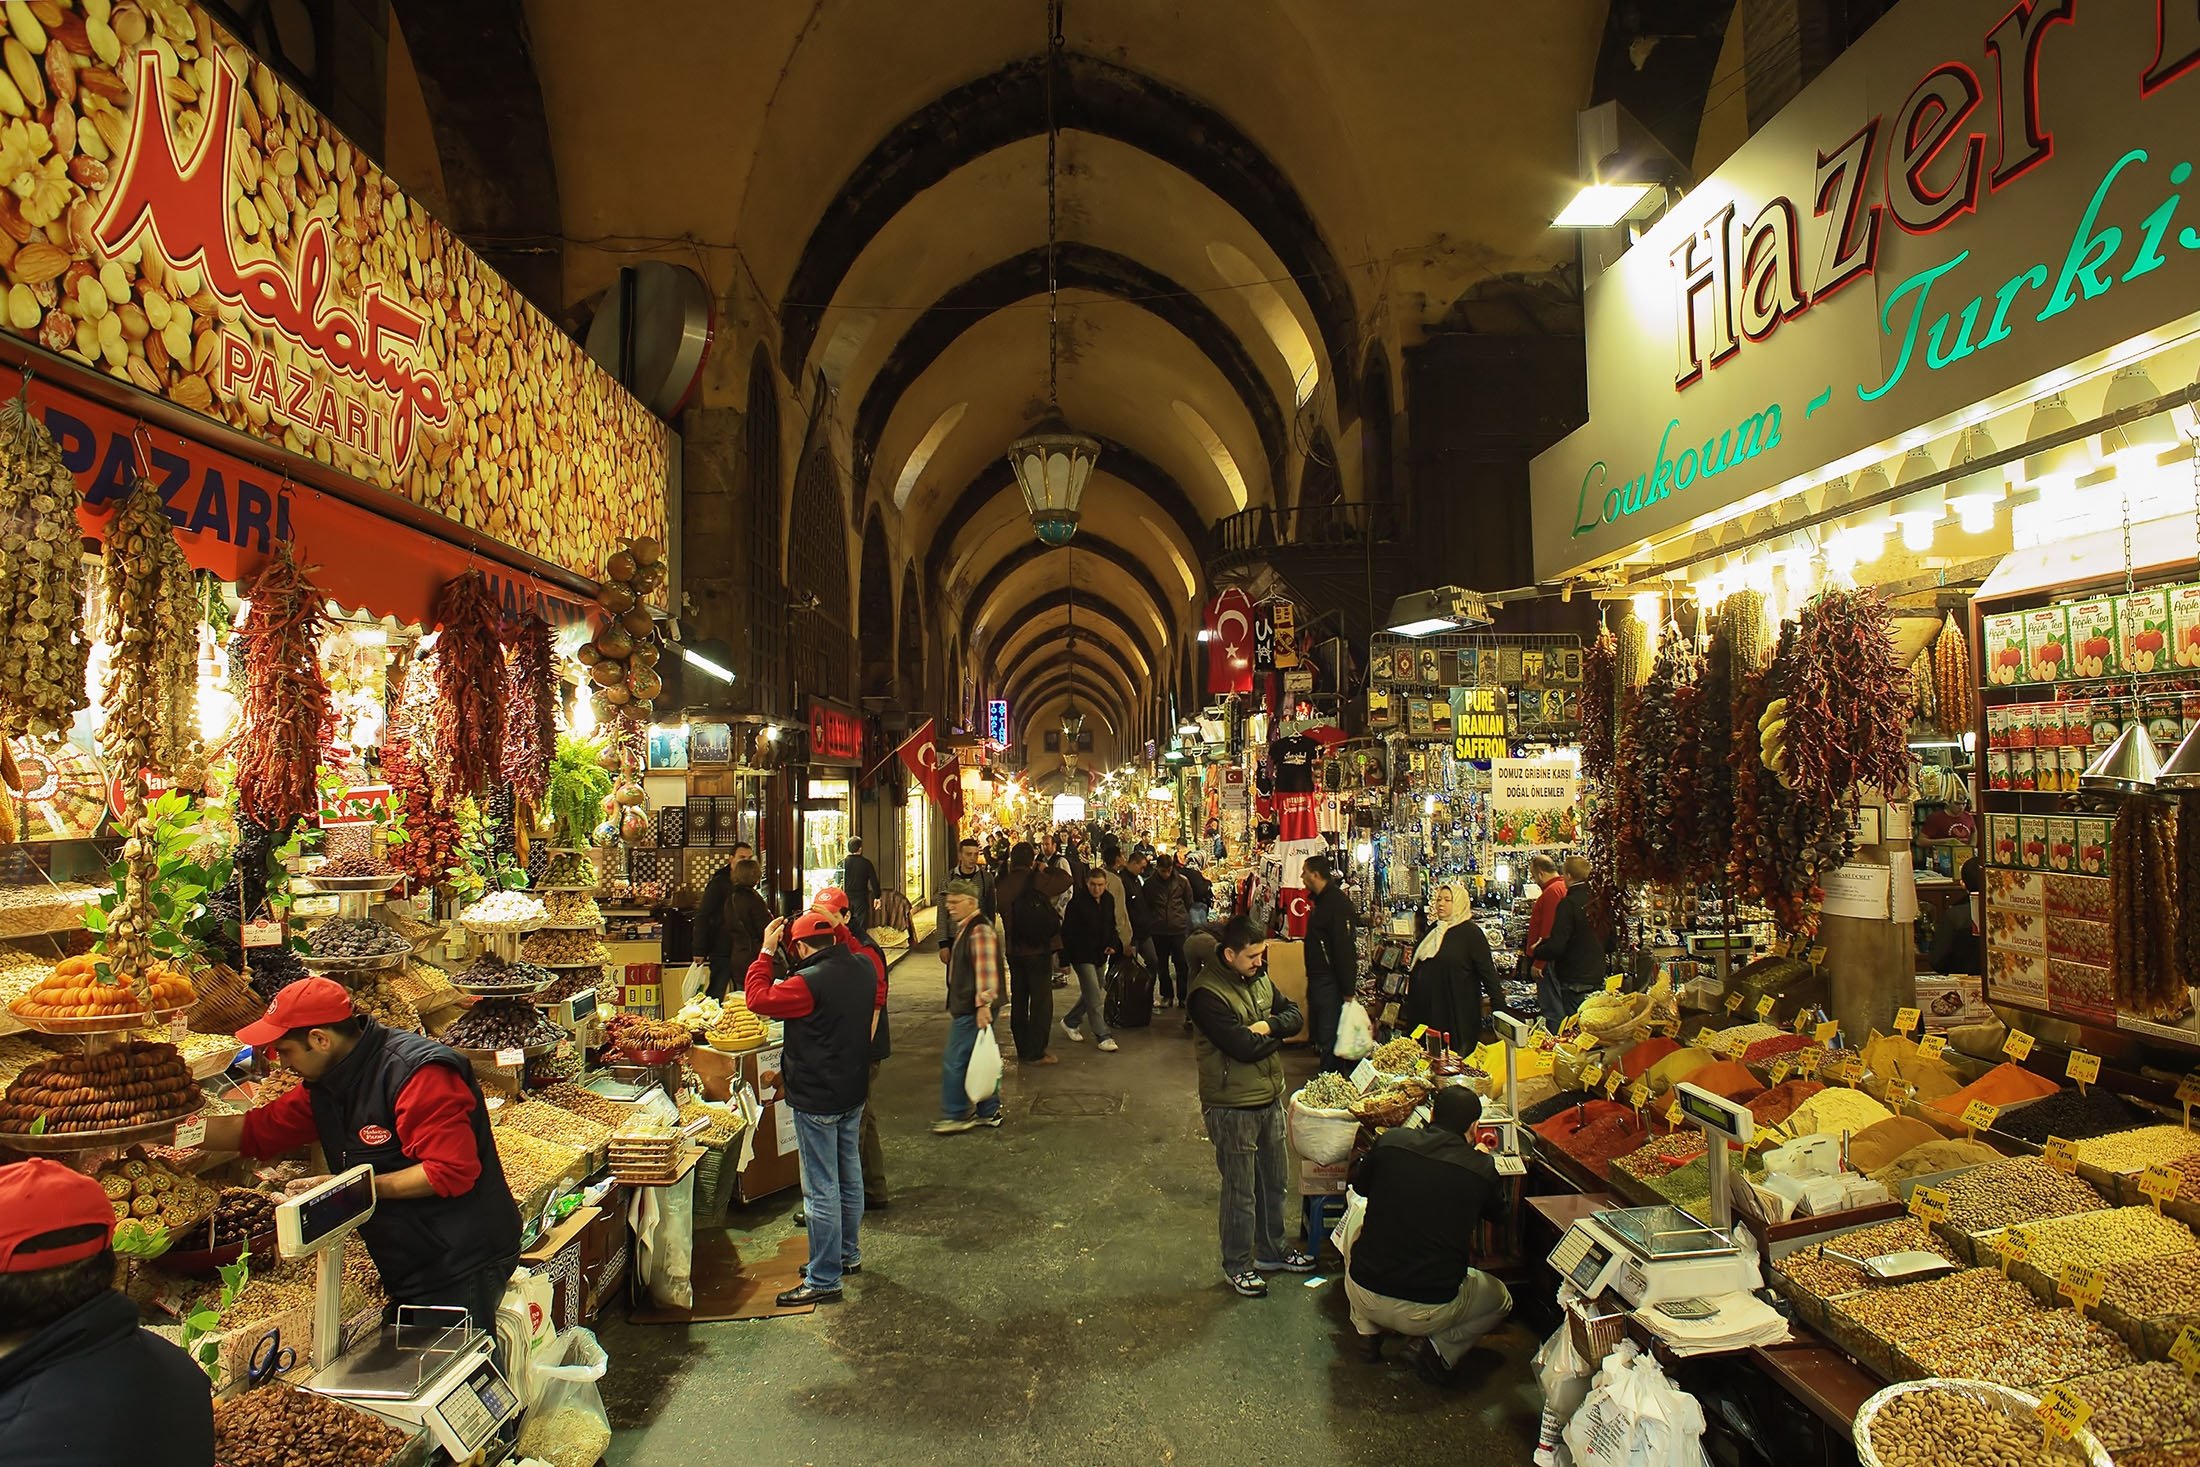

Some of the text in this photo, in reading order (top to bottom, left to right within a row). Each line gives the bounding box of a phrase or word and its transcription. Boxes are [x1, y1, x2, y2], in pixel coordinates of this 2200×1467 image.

[1669, 0, 2078, 392] Hazer
[93, 48, 452, 477] Malatya
[220, 329, 383, 458] PAZARI
[44, 406, 292, 557] PAZARI
[1571, 402, 1783, 541] Loukoum
[2095, 612, 2109, 624] Tea
[2148, 605, 2163, 616] Tea
[2010, 625, 2021, 635] Tea
[2051, 619, 2062, 629] Tea
[1464, 690, 1497, 711] PURE
[1458, 714, 1504, 736] IRANIAN
[1455, 737, 1508, 760] SAFFRON
[1498, 768, 1523, 779] DOMUZ
[1506, 785, 1565, 797] DOĞAL ÖNLEMLER
